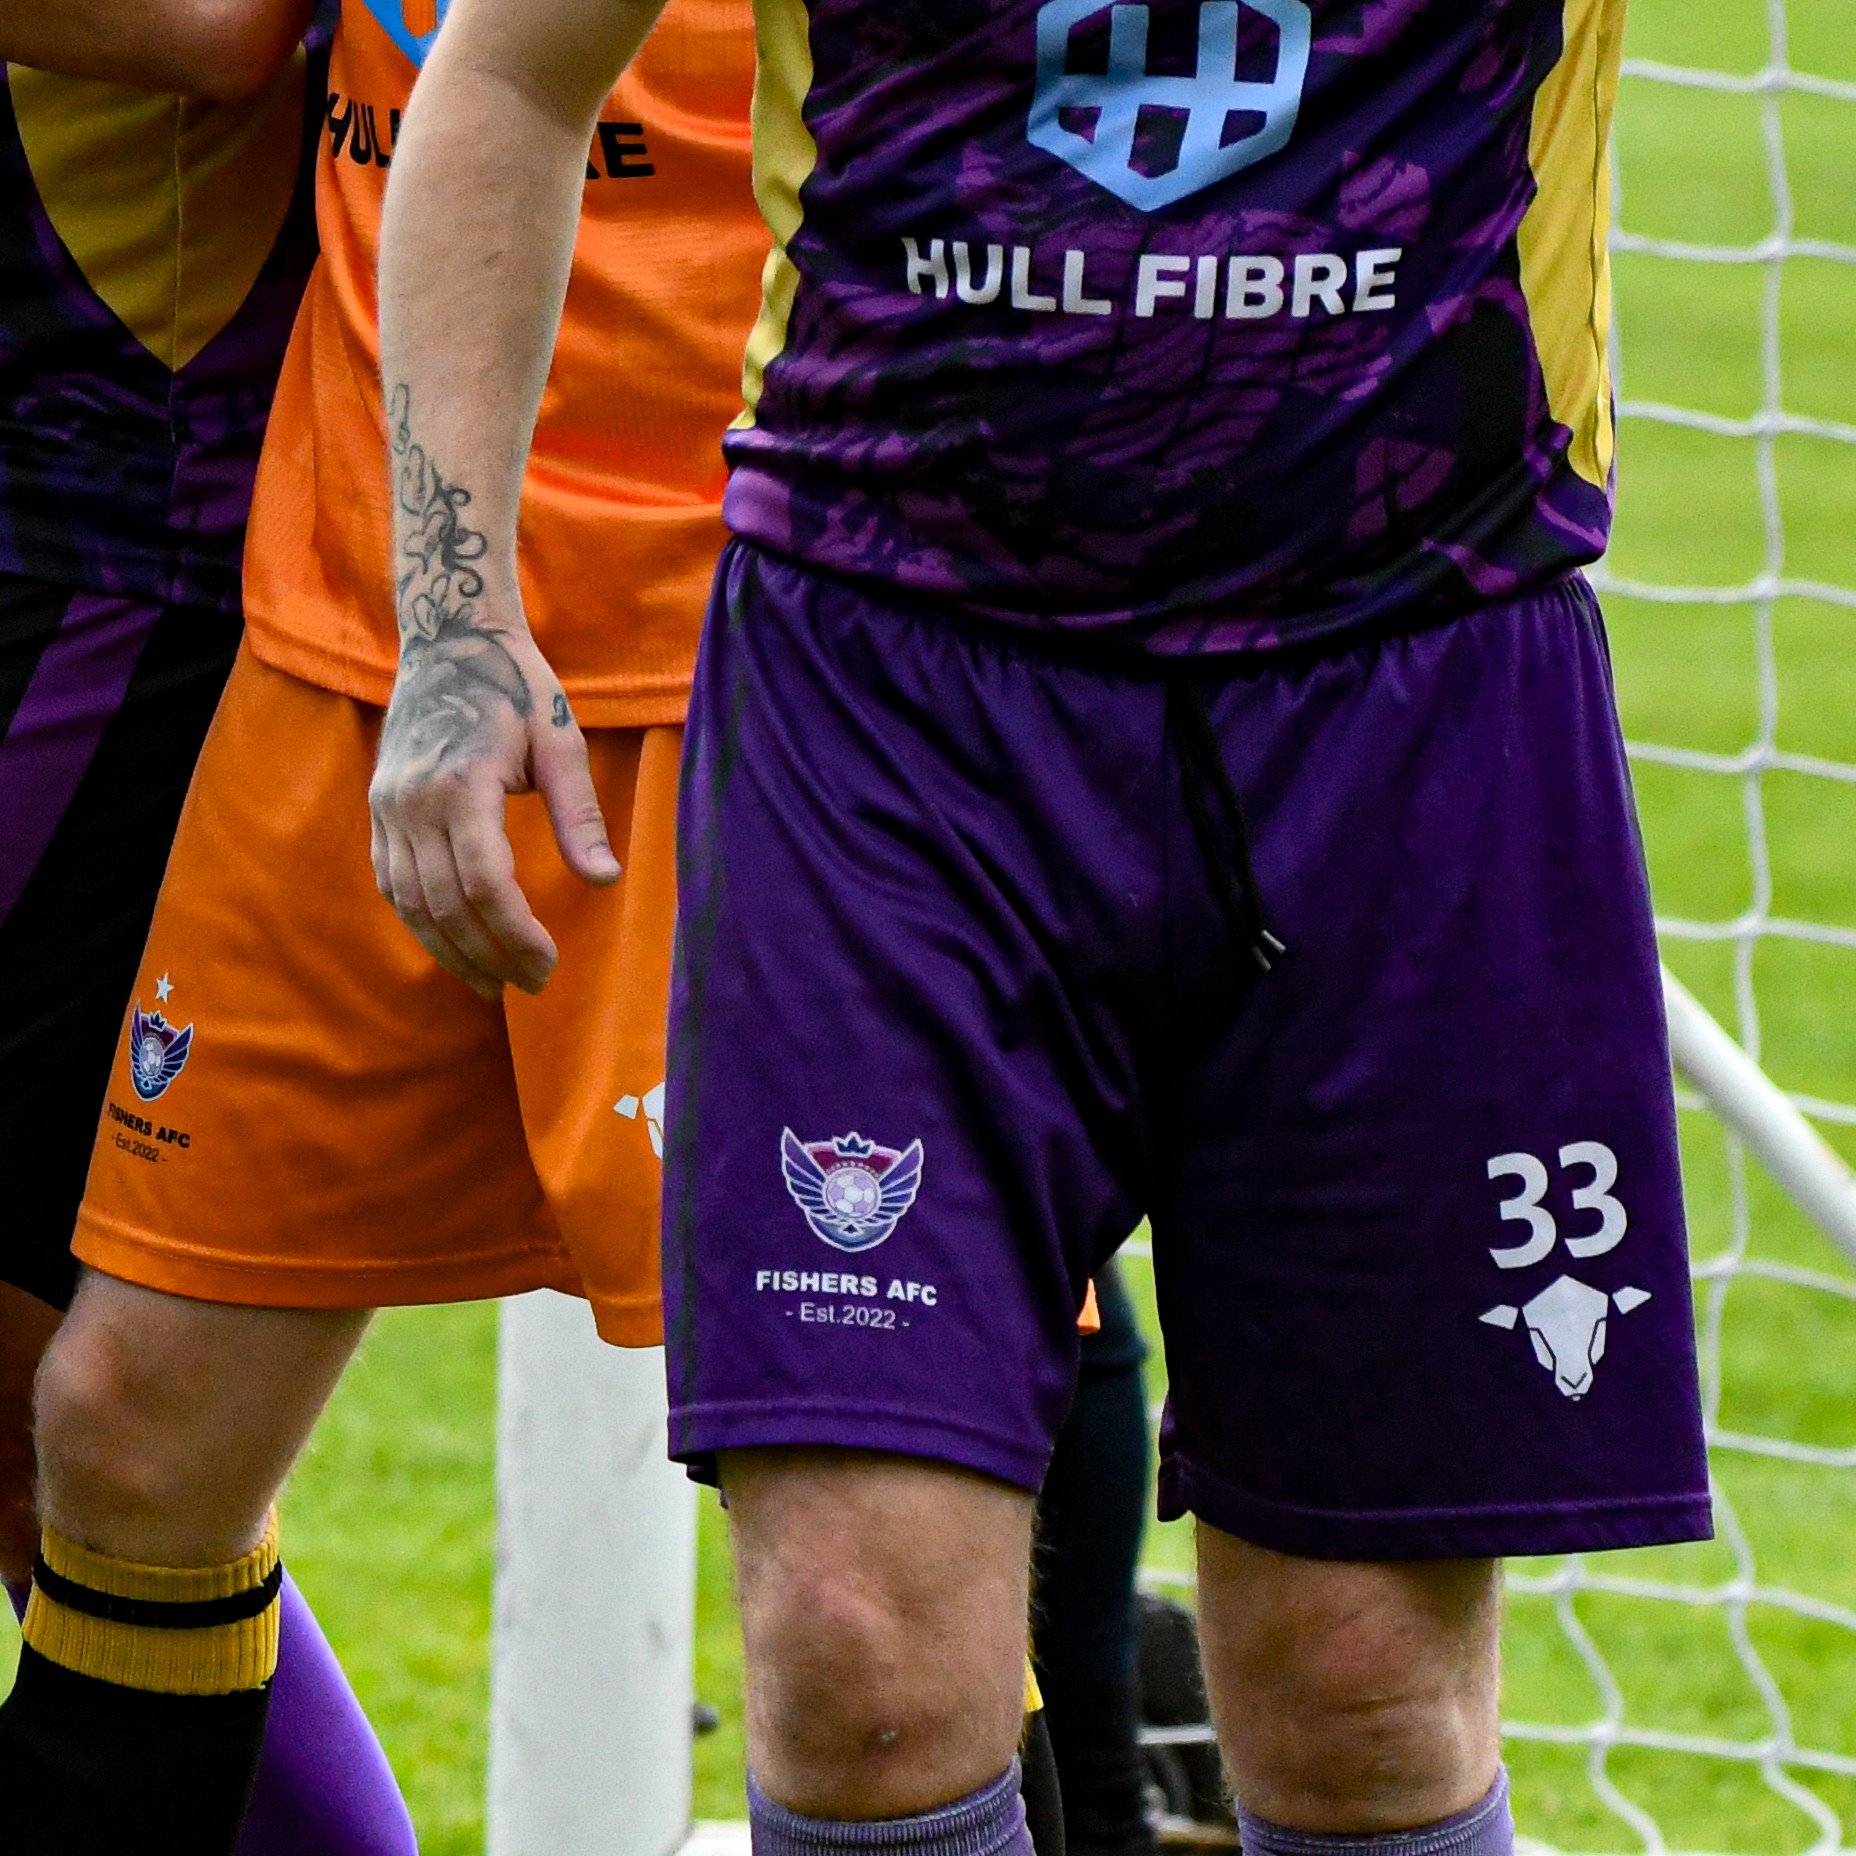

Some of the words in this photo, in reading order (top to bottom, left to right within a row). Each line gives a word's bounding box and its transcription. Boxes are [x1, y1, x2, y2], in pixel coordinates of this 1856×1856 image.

[901, 237, 1112, 315] HULL
[1135, 248, 1402, 320] FIBRE
[155, 1126, 191, 1149] AFC
[1487, 1141, 1628, 1269] 33
[756, 1270, 878, 1297] FISHERS
[886, 1279, 937, 1306] AFC
